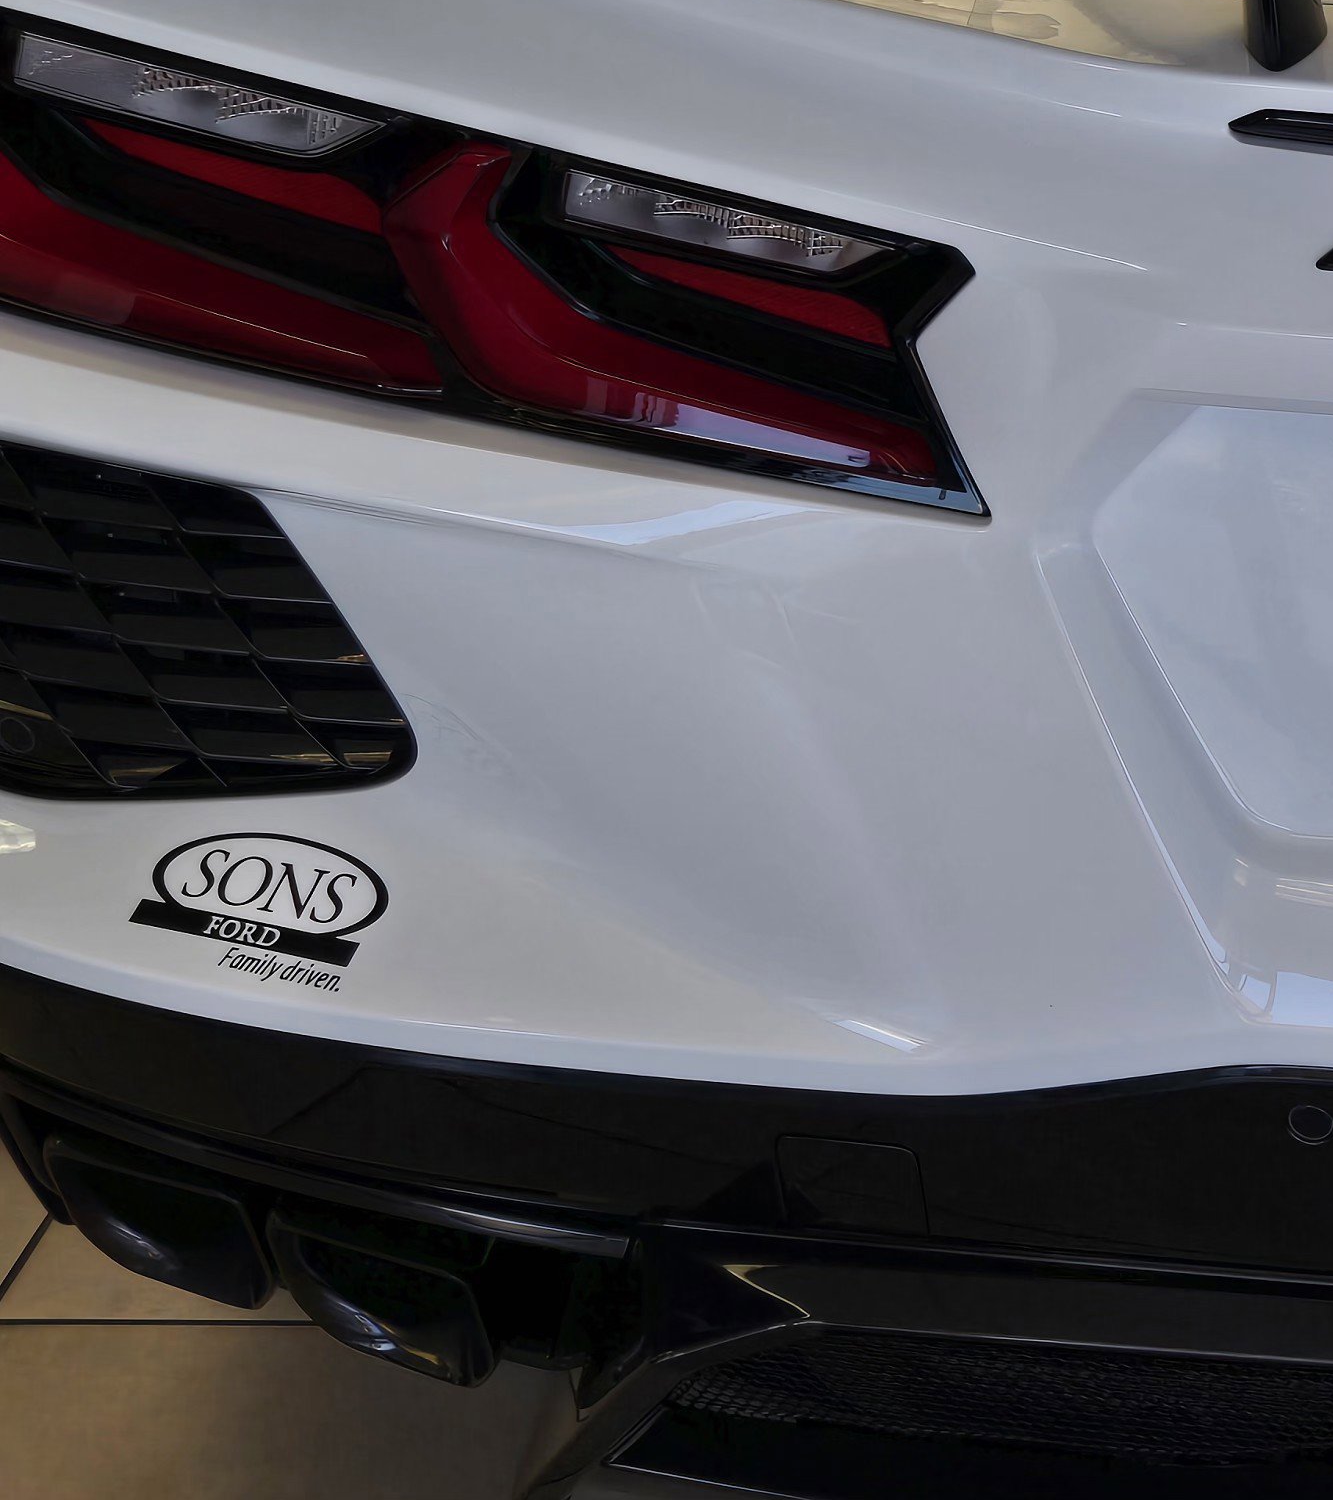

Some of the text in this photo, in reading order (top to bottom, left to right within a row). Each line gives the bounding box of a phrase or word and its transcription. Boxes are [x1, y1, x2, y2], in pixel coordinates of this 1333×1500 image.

[181, 848, 358, 924] SONS
[203, 915, 281, 947] FORD
[217, 946, 341, 993] Family driven.
